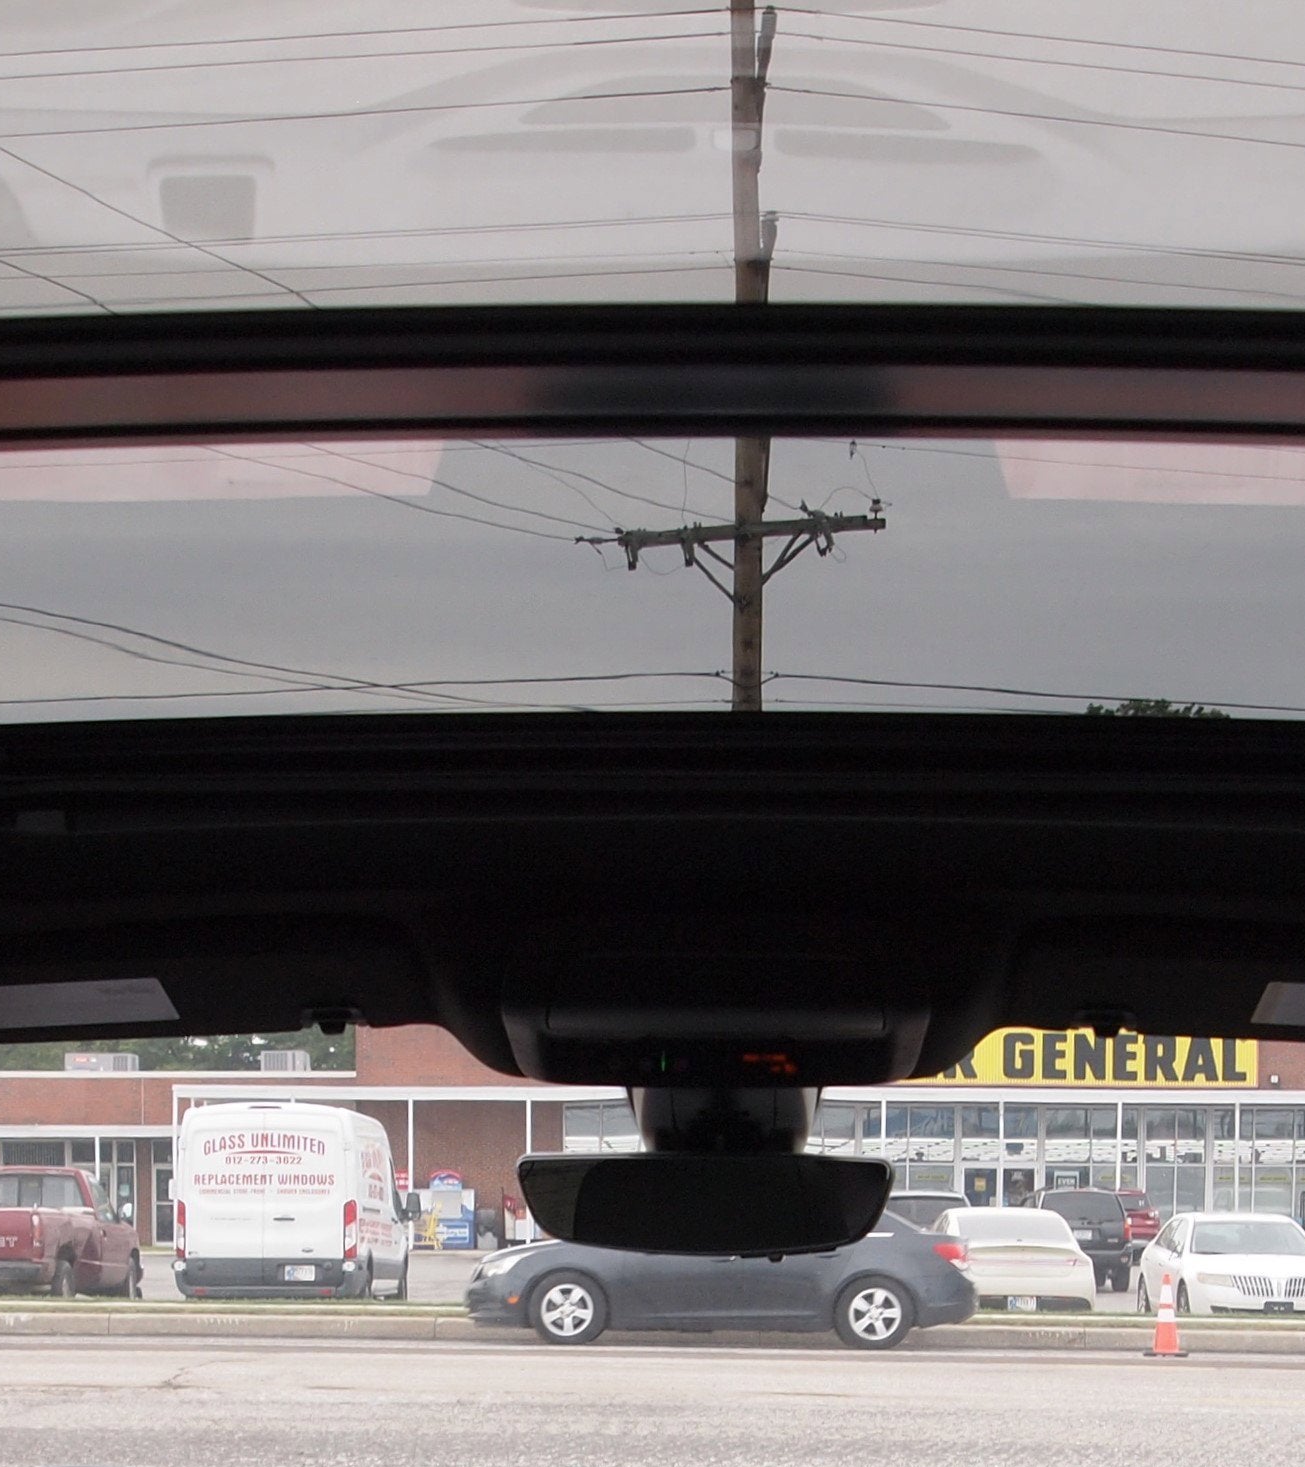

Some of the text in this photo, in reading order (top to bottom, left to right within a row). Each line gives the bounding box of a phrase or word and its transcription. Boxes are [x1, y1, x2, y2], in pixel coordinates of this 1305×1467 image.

[1002, 1032, 1248, 1082] GENERAL
[203, 1132, 326, 1156] GLASS UNLIMITED
[194, 1174, 335, 1186] REPLACEMENT WINDOWS
